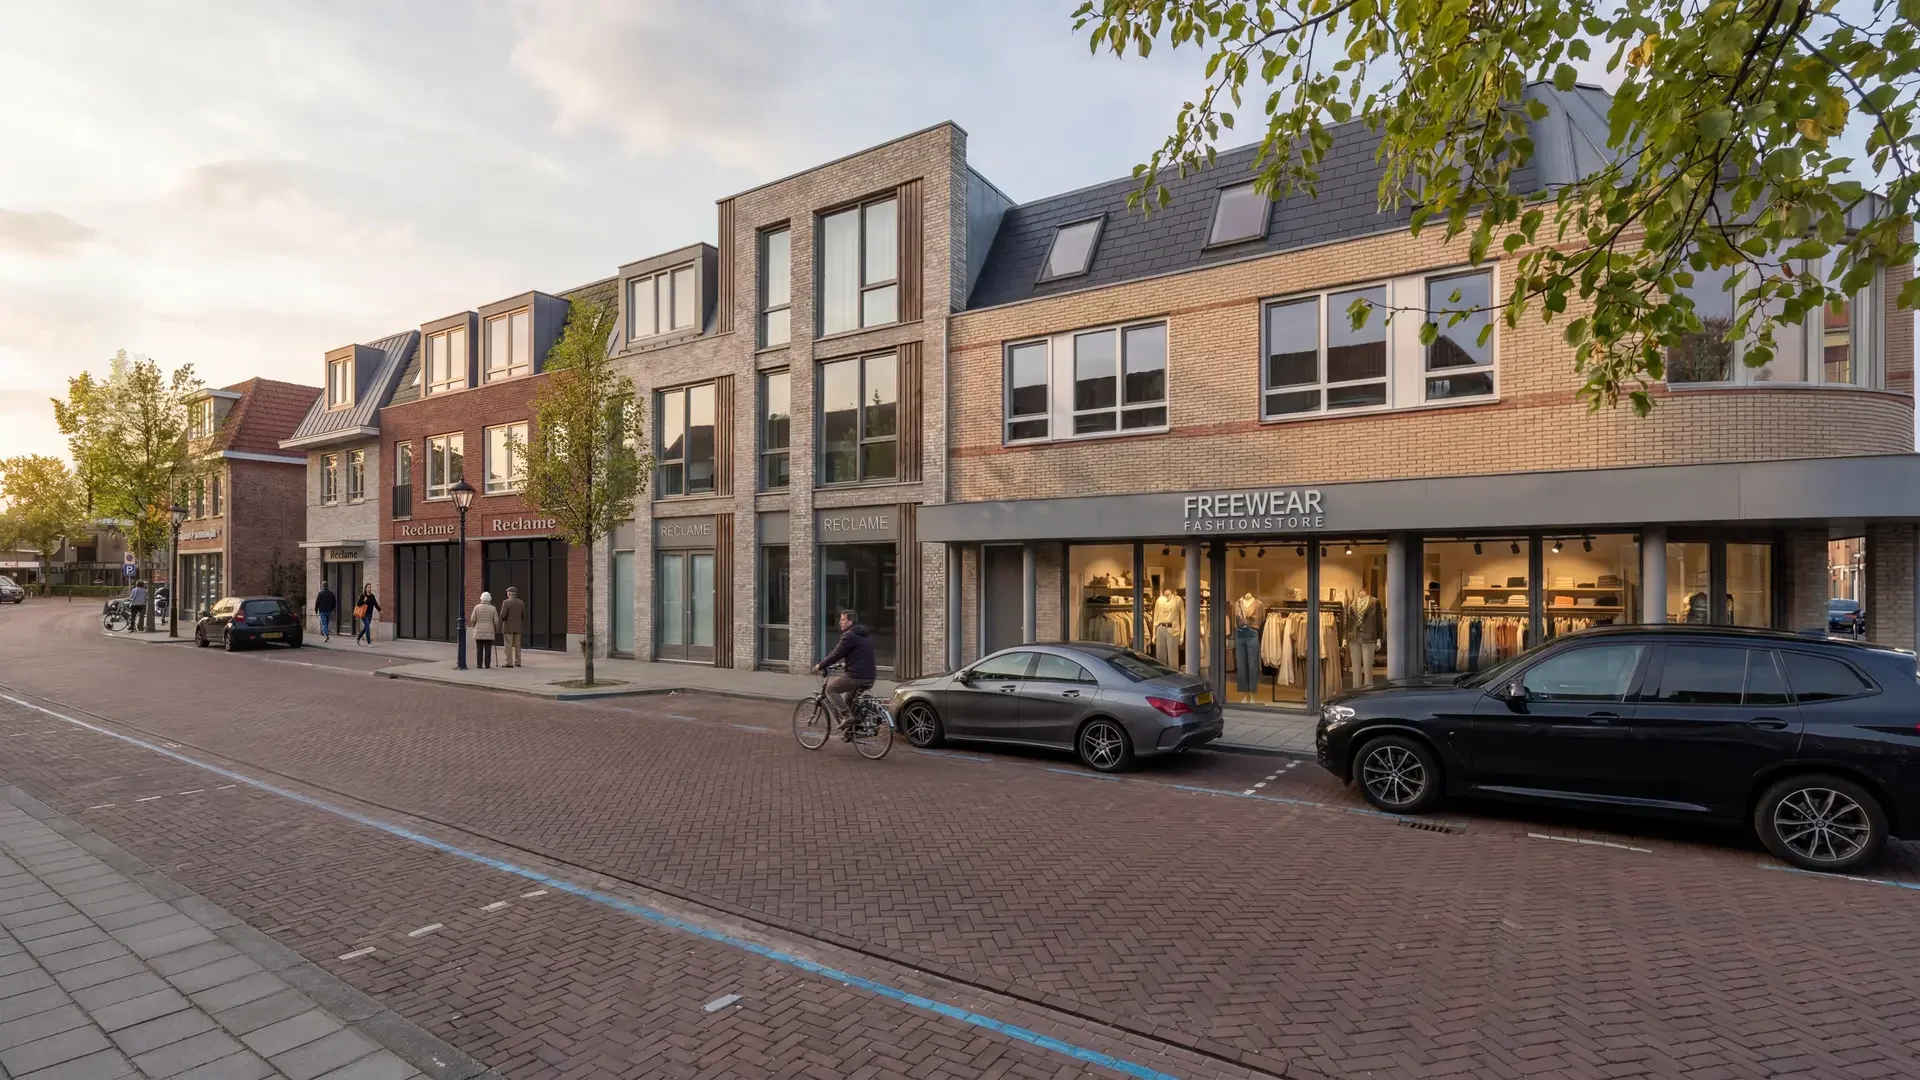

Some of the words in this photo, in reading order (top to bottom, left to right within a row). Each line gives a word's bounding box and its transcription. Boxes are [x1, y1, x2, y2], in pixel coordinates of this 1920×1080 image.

[1184, 489, 1324, 518] FREEWEAR
[402, 523, 455, 537] Reclame
[492, 517, 556, 532] Reclame
[661, 523, 711, 537] RECLAME
[824, 515, 889, 531] RECLAME
[1184, 516, 1324, 531] FASHIONSTORE
[330, 550, 358, 559] Reclame
